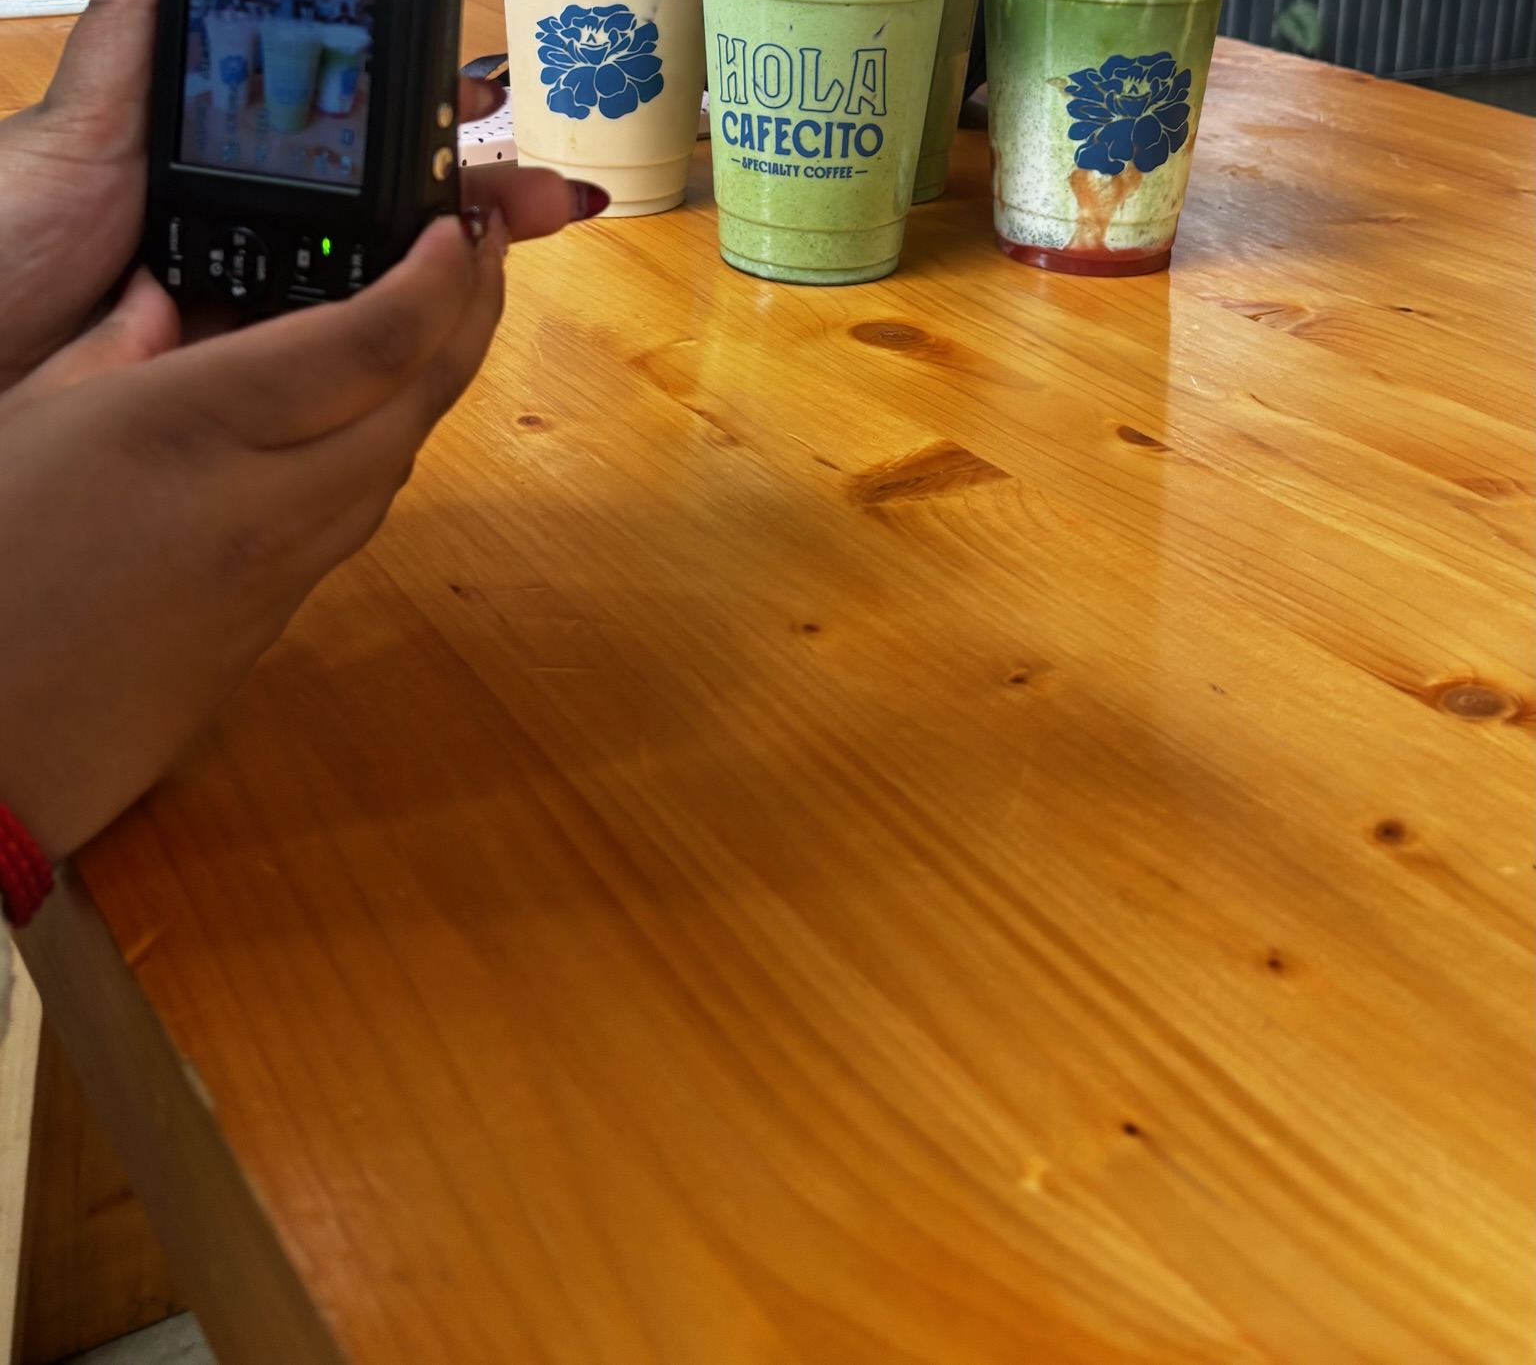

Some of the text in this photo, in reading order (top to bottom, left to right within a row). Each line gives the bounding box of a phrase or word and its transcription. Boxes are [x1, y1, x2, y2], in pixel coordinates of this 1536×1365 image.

[717, 33, 887, 116] HOLA
[721, 110, 884, 158] CAFECITO
[741, 157, 853, 179] SPECIALTY COFFEE
